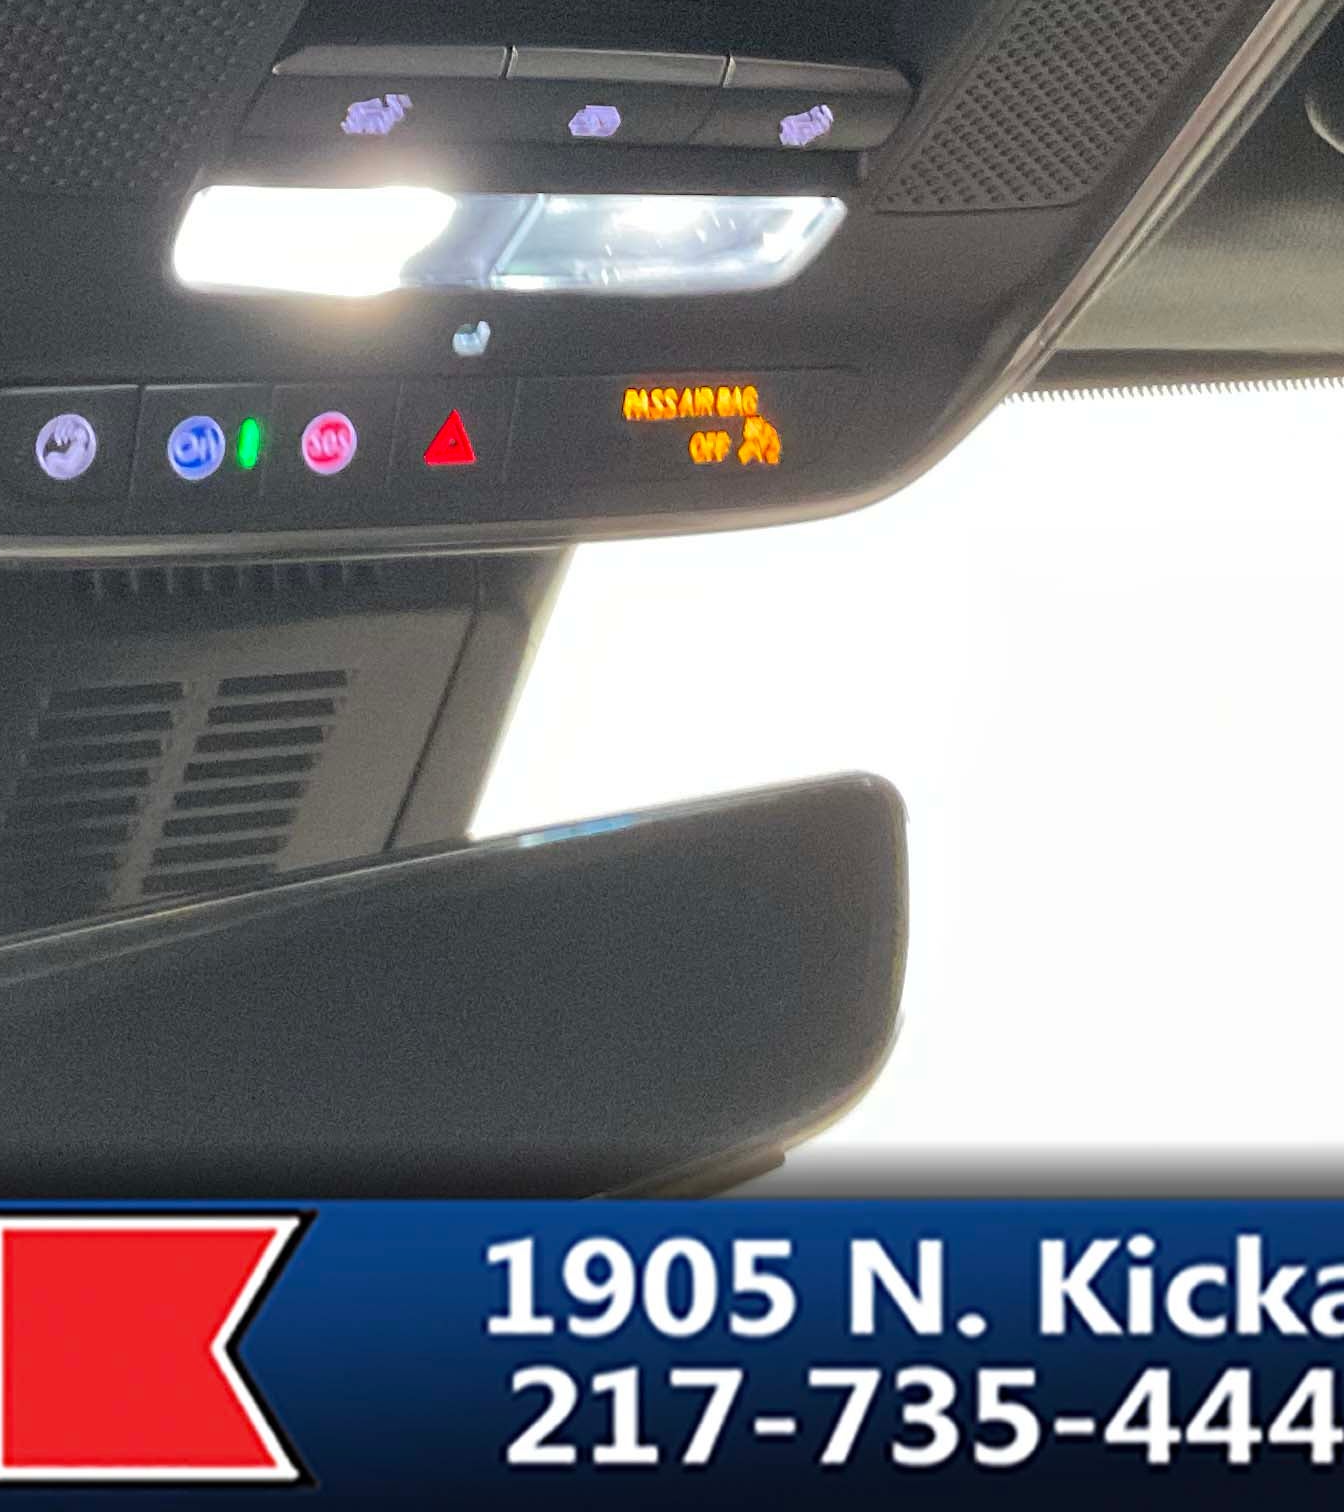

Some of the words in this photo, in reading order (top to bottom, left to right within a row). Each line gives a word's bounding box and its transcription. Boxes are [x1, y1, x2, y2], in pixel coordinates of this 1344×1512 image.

[622, 386, 677, 421] PASS
[678, 386, 714, 418] AIR
[308, 426, 352, 458] SOS
[688, 431, 732, 465] OFF
